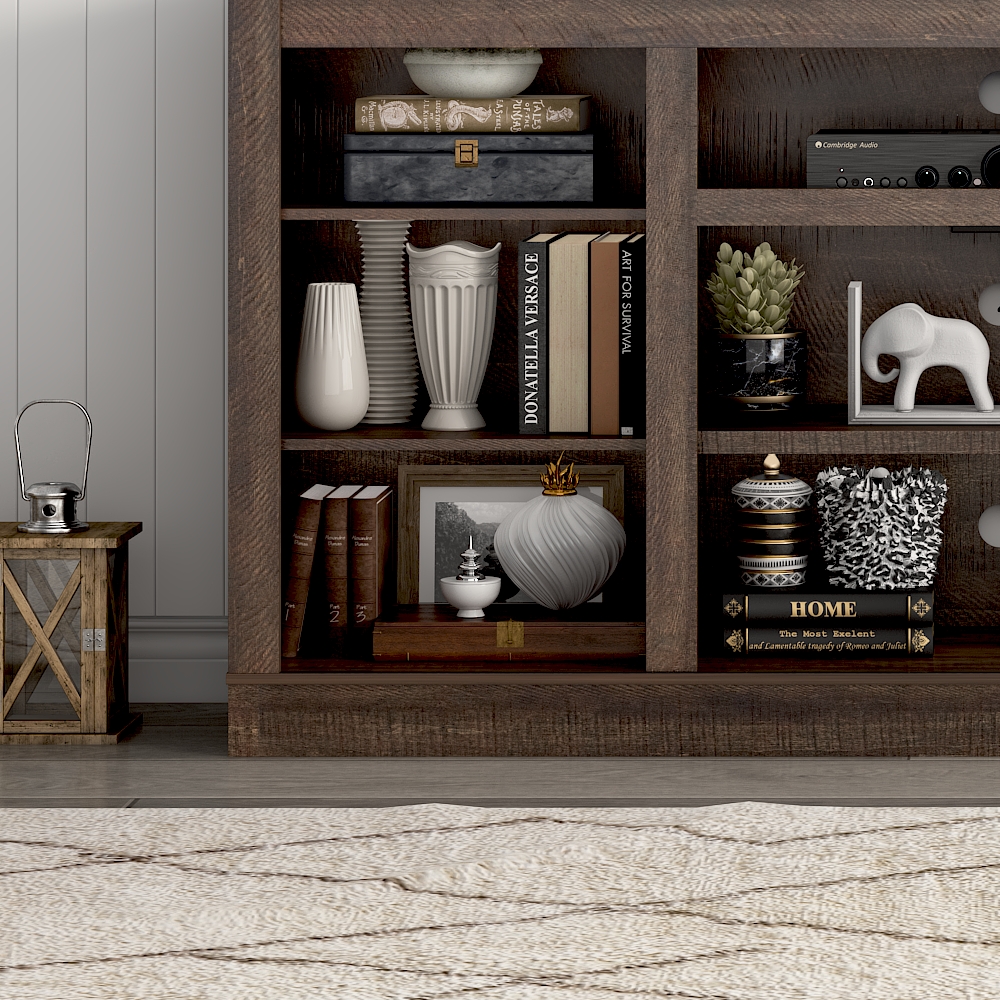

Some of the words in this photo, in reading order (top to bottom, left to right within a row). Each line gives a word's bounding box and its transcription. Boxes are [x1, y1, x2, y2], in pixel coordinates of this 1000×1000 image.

[510, 99, 523, 132] PUNJAB
[532, 99, 545, 130] TALES
[822, 141, 858, 150] Cambridge
[859, 141, 879, 149] Audio
[621, 249, 632, 271] ART
[524, 253, 539, 327] VERSACE
[621, 275, 632, 299] FOR
[621, 302, 632, 355] SURVIVAL
[524, 329, 539, 425] DONATELLA
[329, 610, 340, 623] 2
[355, 610, 367, 624] 3
[790, 601, 858, 618] HOME
[779, 630, 798, 638] The
[802, 630, 828, 638] Most
[832, 630, 876, 638] Exelent
[748, 641, 765, 650] and
[765, 641, 807, 650] Lamentable
[807, 641, 835, 652] tragedy
[836, 641, 847, 652] of
[846, 642, 870, 651] Romeo
[870, 641, 887, 650] and
[886, 641, 907, 651] Juliet
